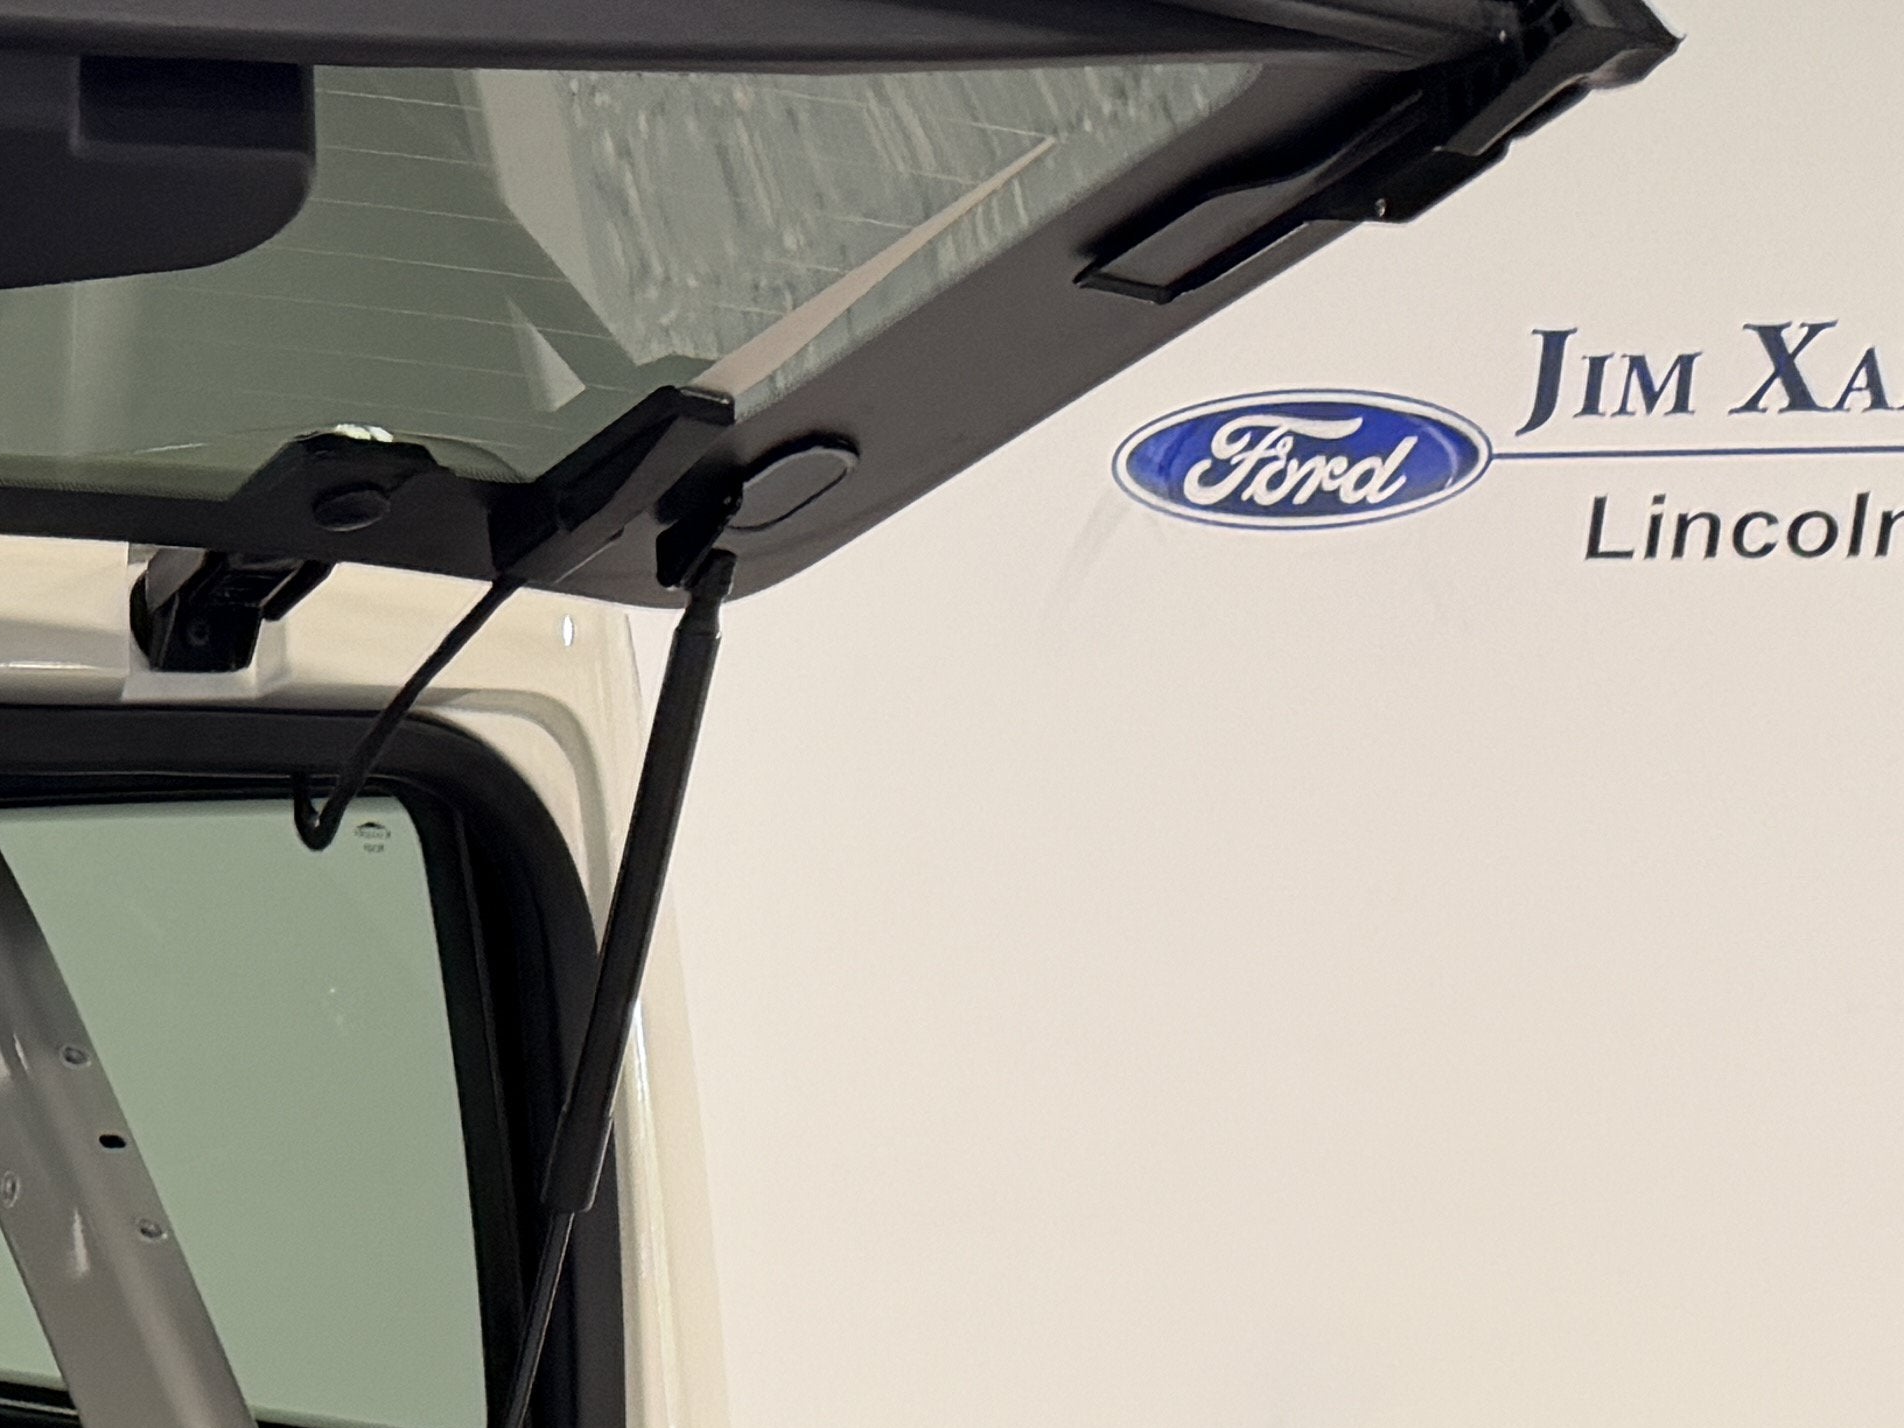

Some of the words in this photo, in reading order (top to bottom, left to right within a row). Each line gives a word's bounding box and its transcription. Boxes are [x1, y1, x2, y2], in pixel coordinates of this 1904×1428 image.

[1514, 326, 1704, 437] JIM
[1727, 318, 1904, 415] XA
[1183, 412, 1419, 507] Ford
